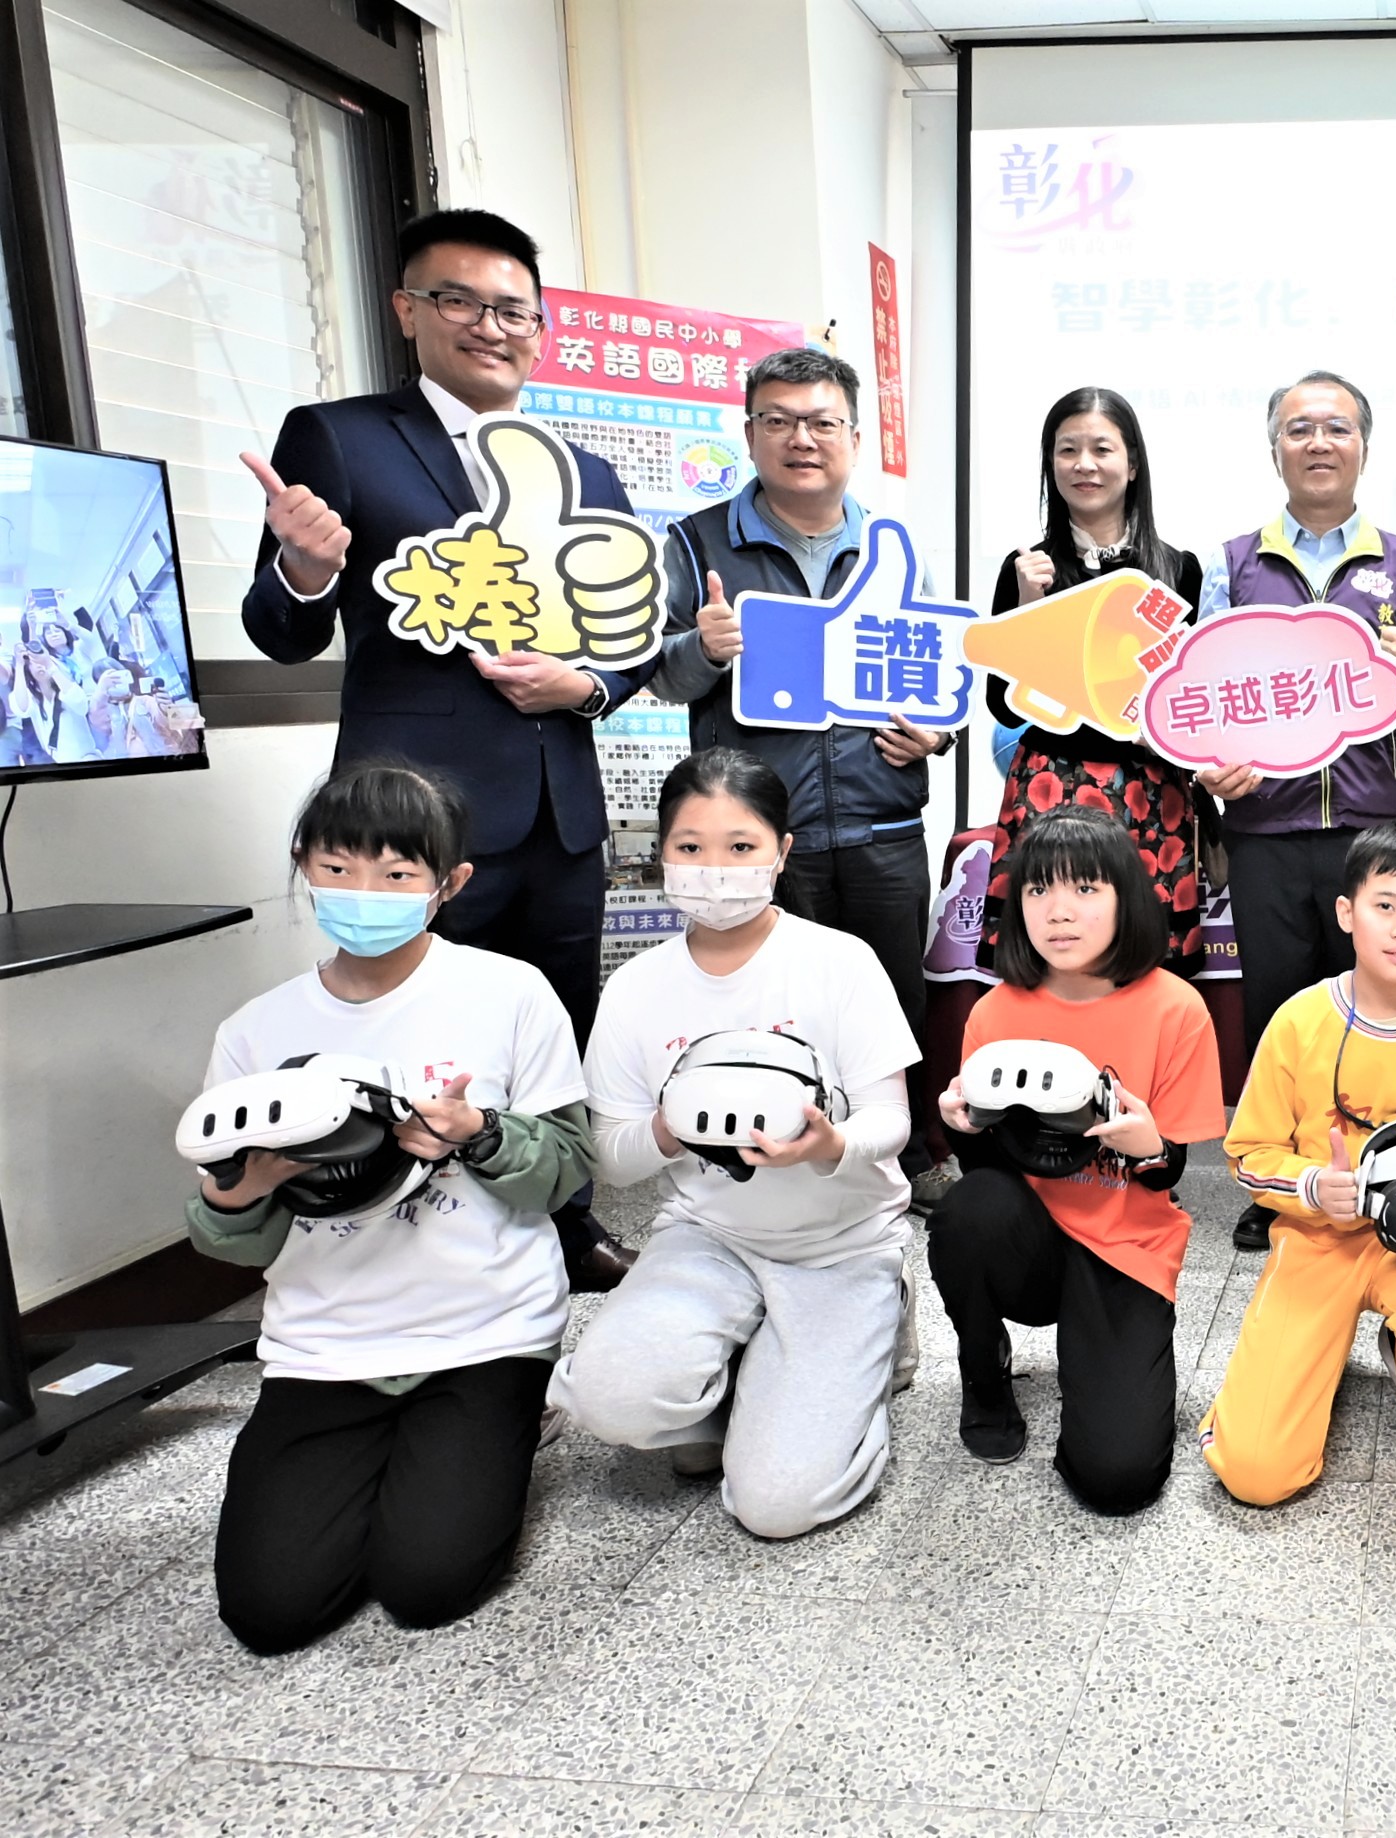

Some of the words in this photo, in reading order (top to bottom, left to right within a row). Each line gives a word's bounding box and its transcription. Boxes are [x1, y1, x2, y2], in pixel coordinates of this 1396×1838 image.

[559, 306, 742, 350] 彰化縣國民中小學
[386, 526, 539, 657] 棒
[854, 614, 943, 705] 讚
[1169, 661, 1375, 734] 卓越彰化
